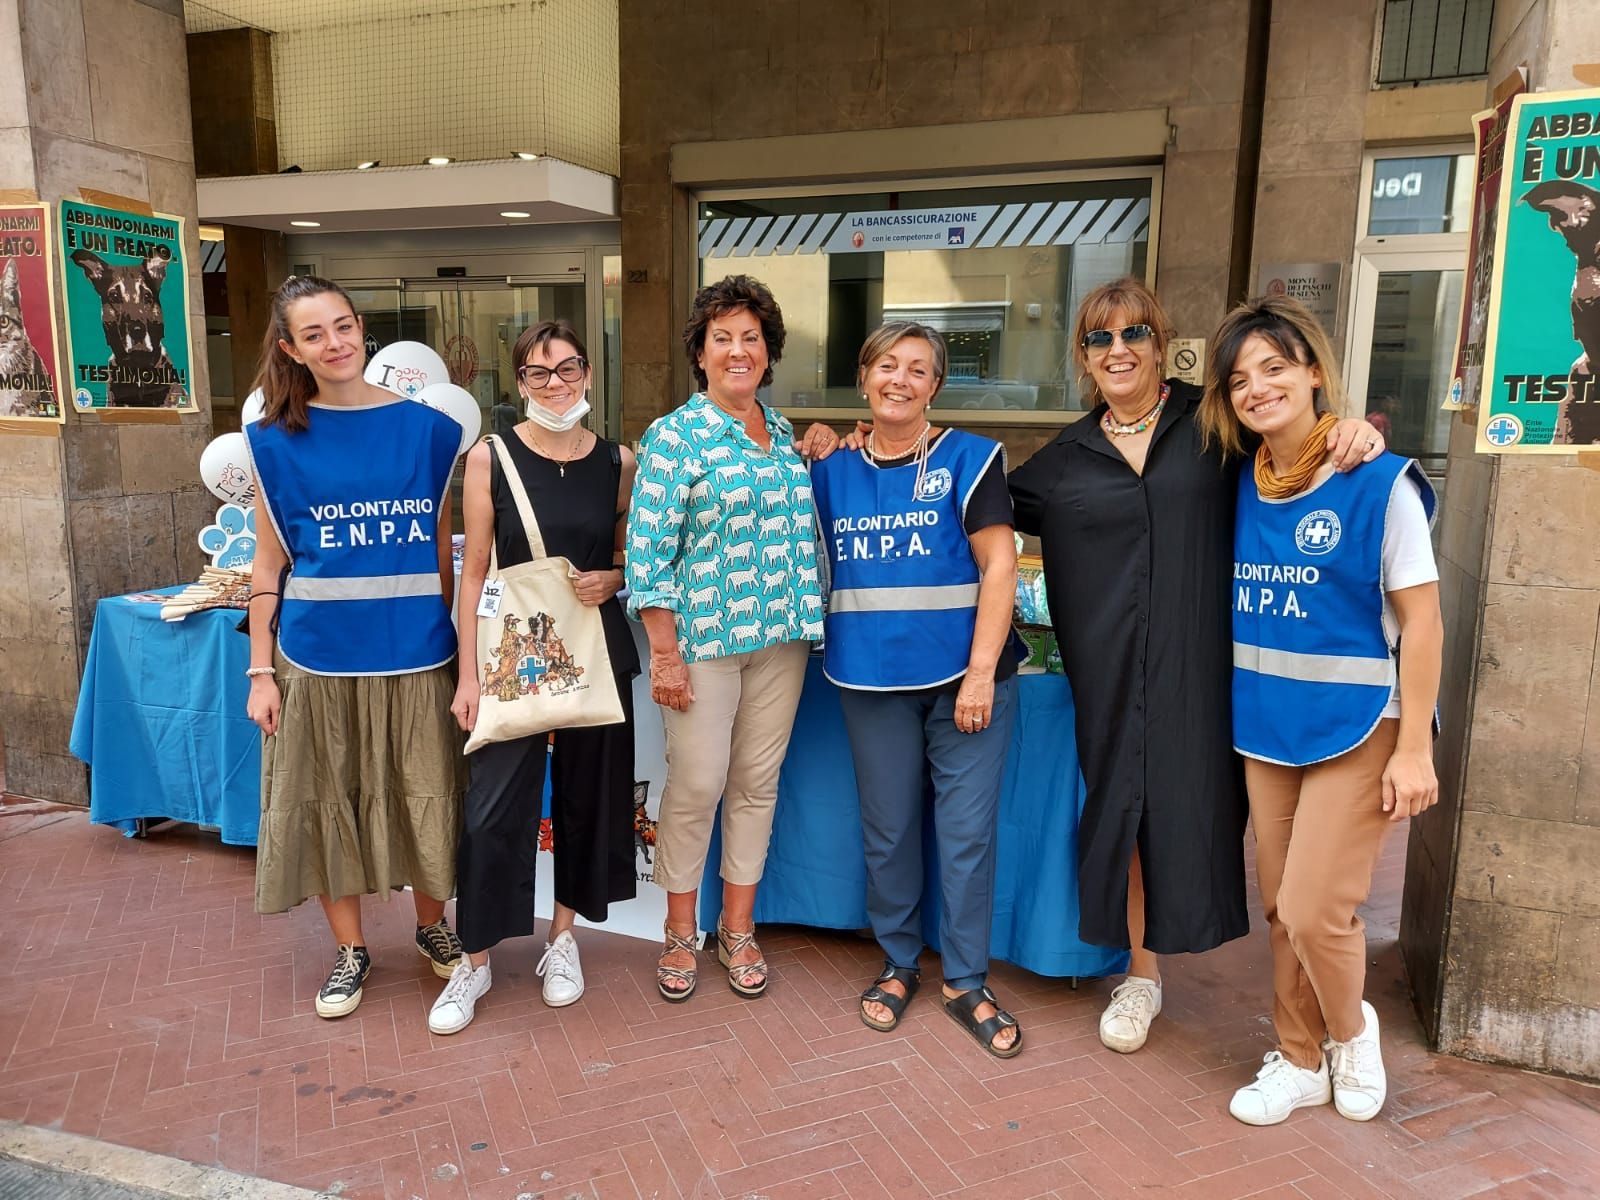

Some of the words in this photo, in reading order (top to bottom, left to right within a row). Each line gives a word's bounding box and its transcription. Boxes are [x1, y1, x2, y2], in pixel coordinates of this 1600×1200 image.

[0, 215, 40, 231] NARMI
[66, 208, 176, 241] ABBANDONARMI
[852, 216, 864, 227] LA
[866, 212, 977, 226] BANCASSICURAZIONE
[81, 230, 109, 254] UN
[114, 236, 179, 263] REATO.
[78, 364, 186, 386] TESTIMONIA!
[309, 498, 433, 522] VOLONTARIO
[832, 509, 939, 535] VOLONTARIO
